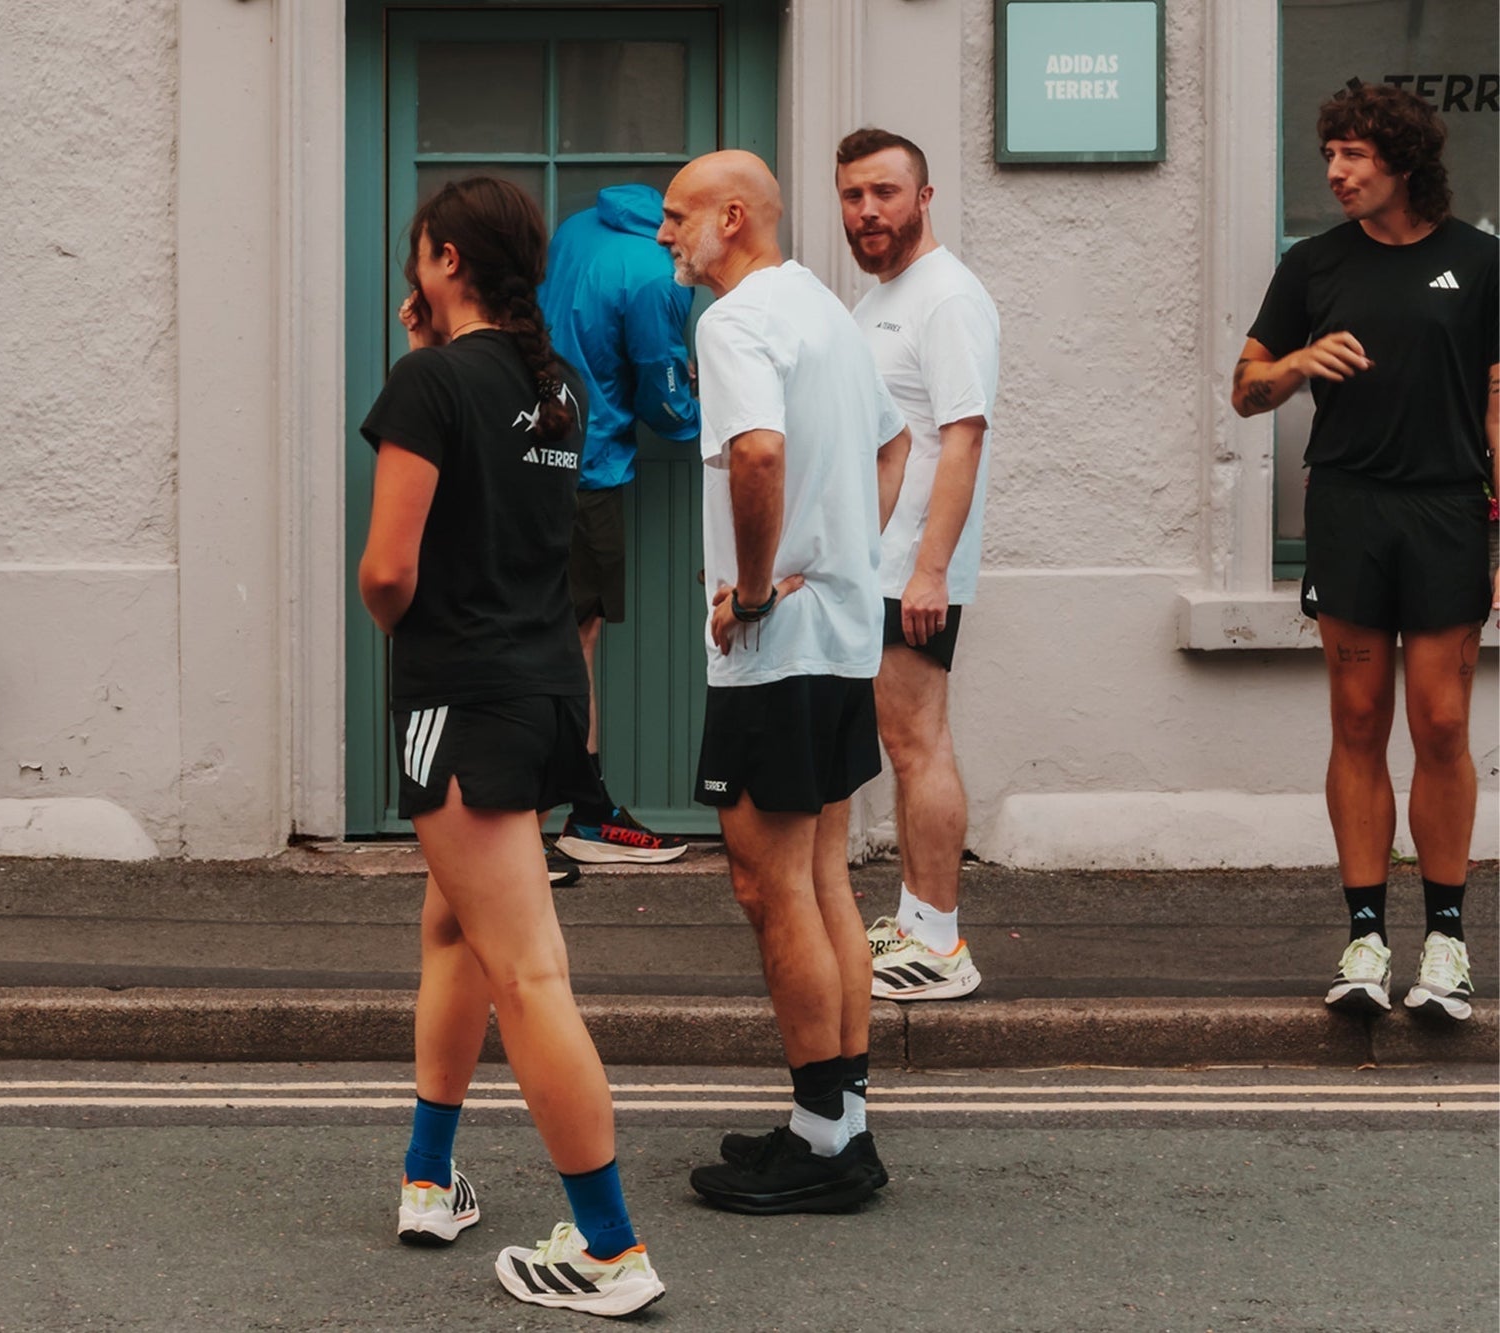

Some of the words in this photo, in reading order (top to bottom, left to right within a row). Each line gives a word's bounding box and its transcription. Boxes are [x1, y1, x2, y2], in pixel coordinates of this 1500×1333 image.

[1045, 54, 1119, 74] ADIDAS
[1044, 80, 1120, 99] TERREX
[540, 448, 579, 470] TERREX
[601, 823, 662, 850] TERREX
